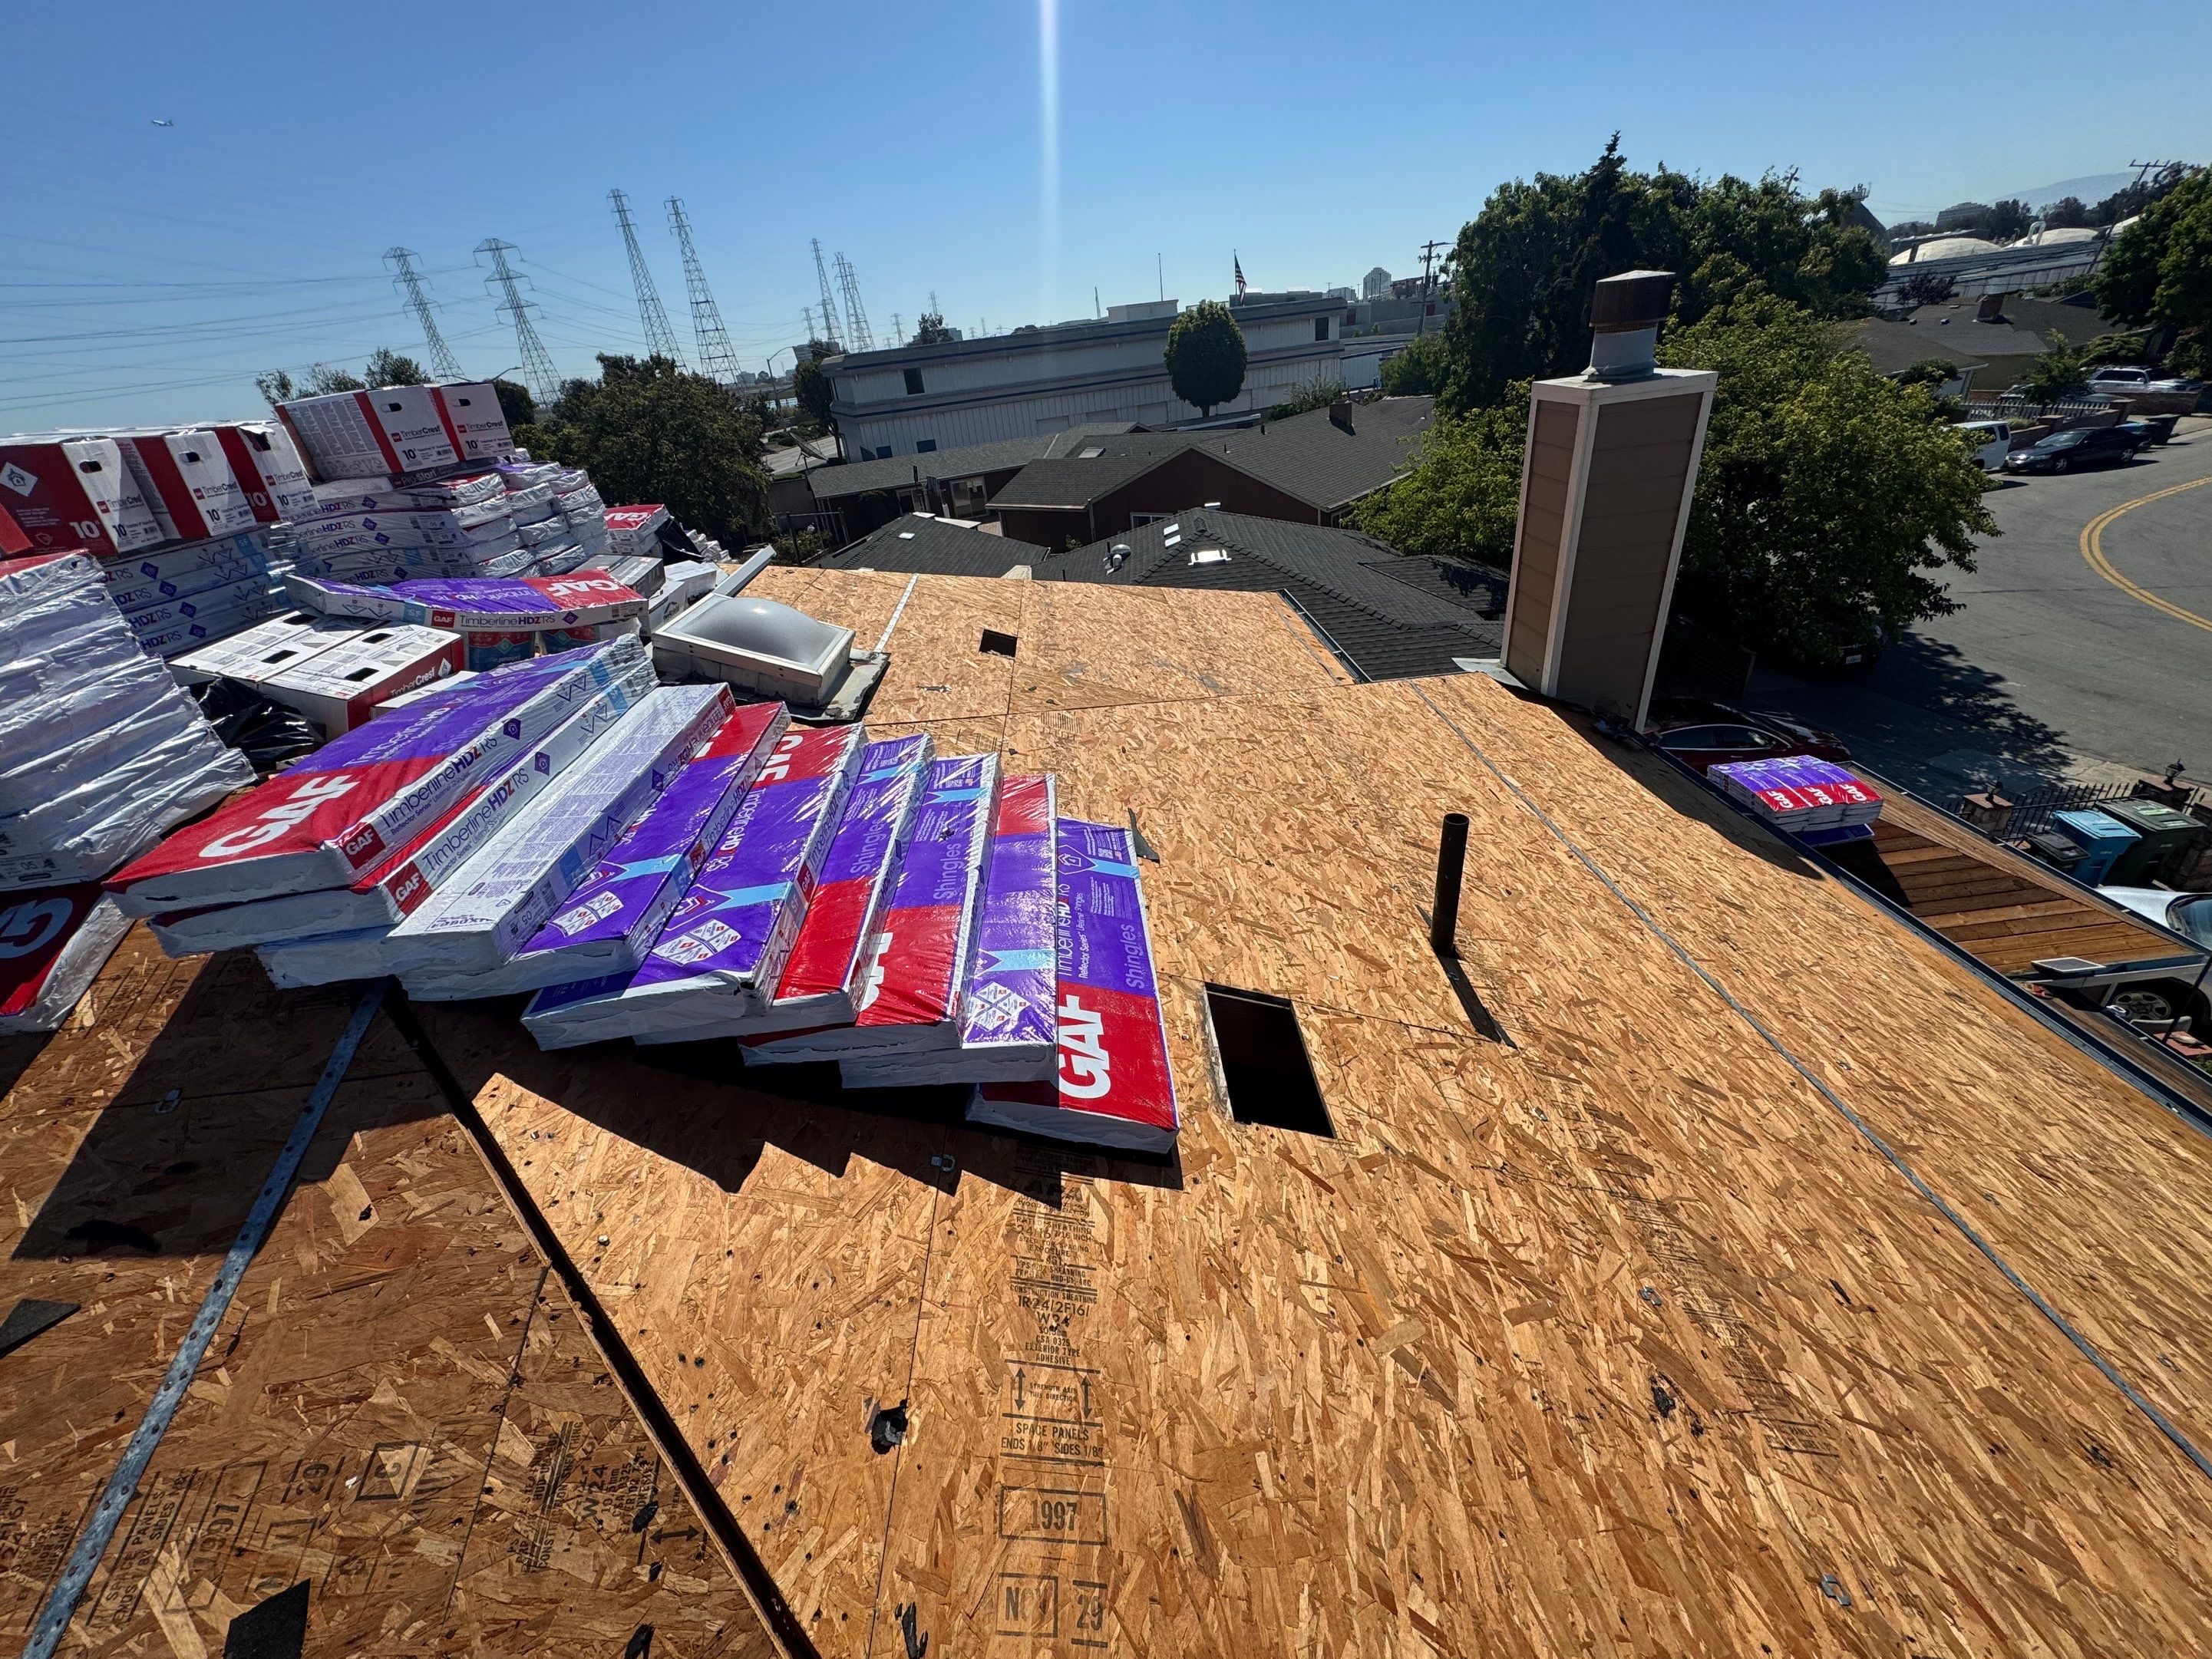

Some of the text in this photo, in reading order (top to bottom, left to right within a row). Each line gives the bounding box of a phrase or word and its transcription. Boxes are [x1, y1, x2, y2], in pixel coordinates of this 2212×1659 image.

[401, 425, 441, 438] TimberCrest
[546, 579, 620, 597] GAF
[1766, 790, 1794, 808] GAF
[1840, 783, 1867, 802] GAF
[199, 773, 360, 858] GAF
[345, 830, 375, 856] GAF
[850, 819, 887, 874] Shingles
[933, 843, 965, 900] Shingles
[395, 873, 421, 902] GAF
[1078, 951, 1090, 979] Reflector
[1121, 924, 1144, 989] Shingles
[1058, 994, 1112, 1099] GAF
[1061, 1292, 1098, 1304] SHEATHING
[1035, 1335, 1050, 1344] CSA
[1025, 1342, 1081, 1357] EXTERIOR TYPE
[1035, 1354, 1071, 1366] ADHESIVE
[1029, 1382, 1060, 1391] STRENGTH
[1045, 1393, 1078, 1402] DIRECTION
[1016, 1423, 1089, 1442] SPACE PANELS
[1001, 1436, 1025, 1450] ENDS
[1054, 1441, 1081, 1456] SIDES
[1031, 1500, 1078, 1531] 1997
[1076, 1595, 1103, 1631] 29
